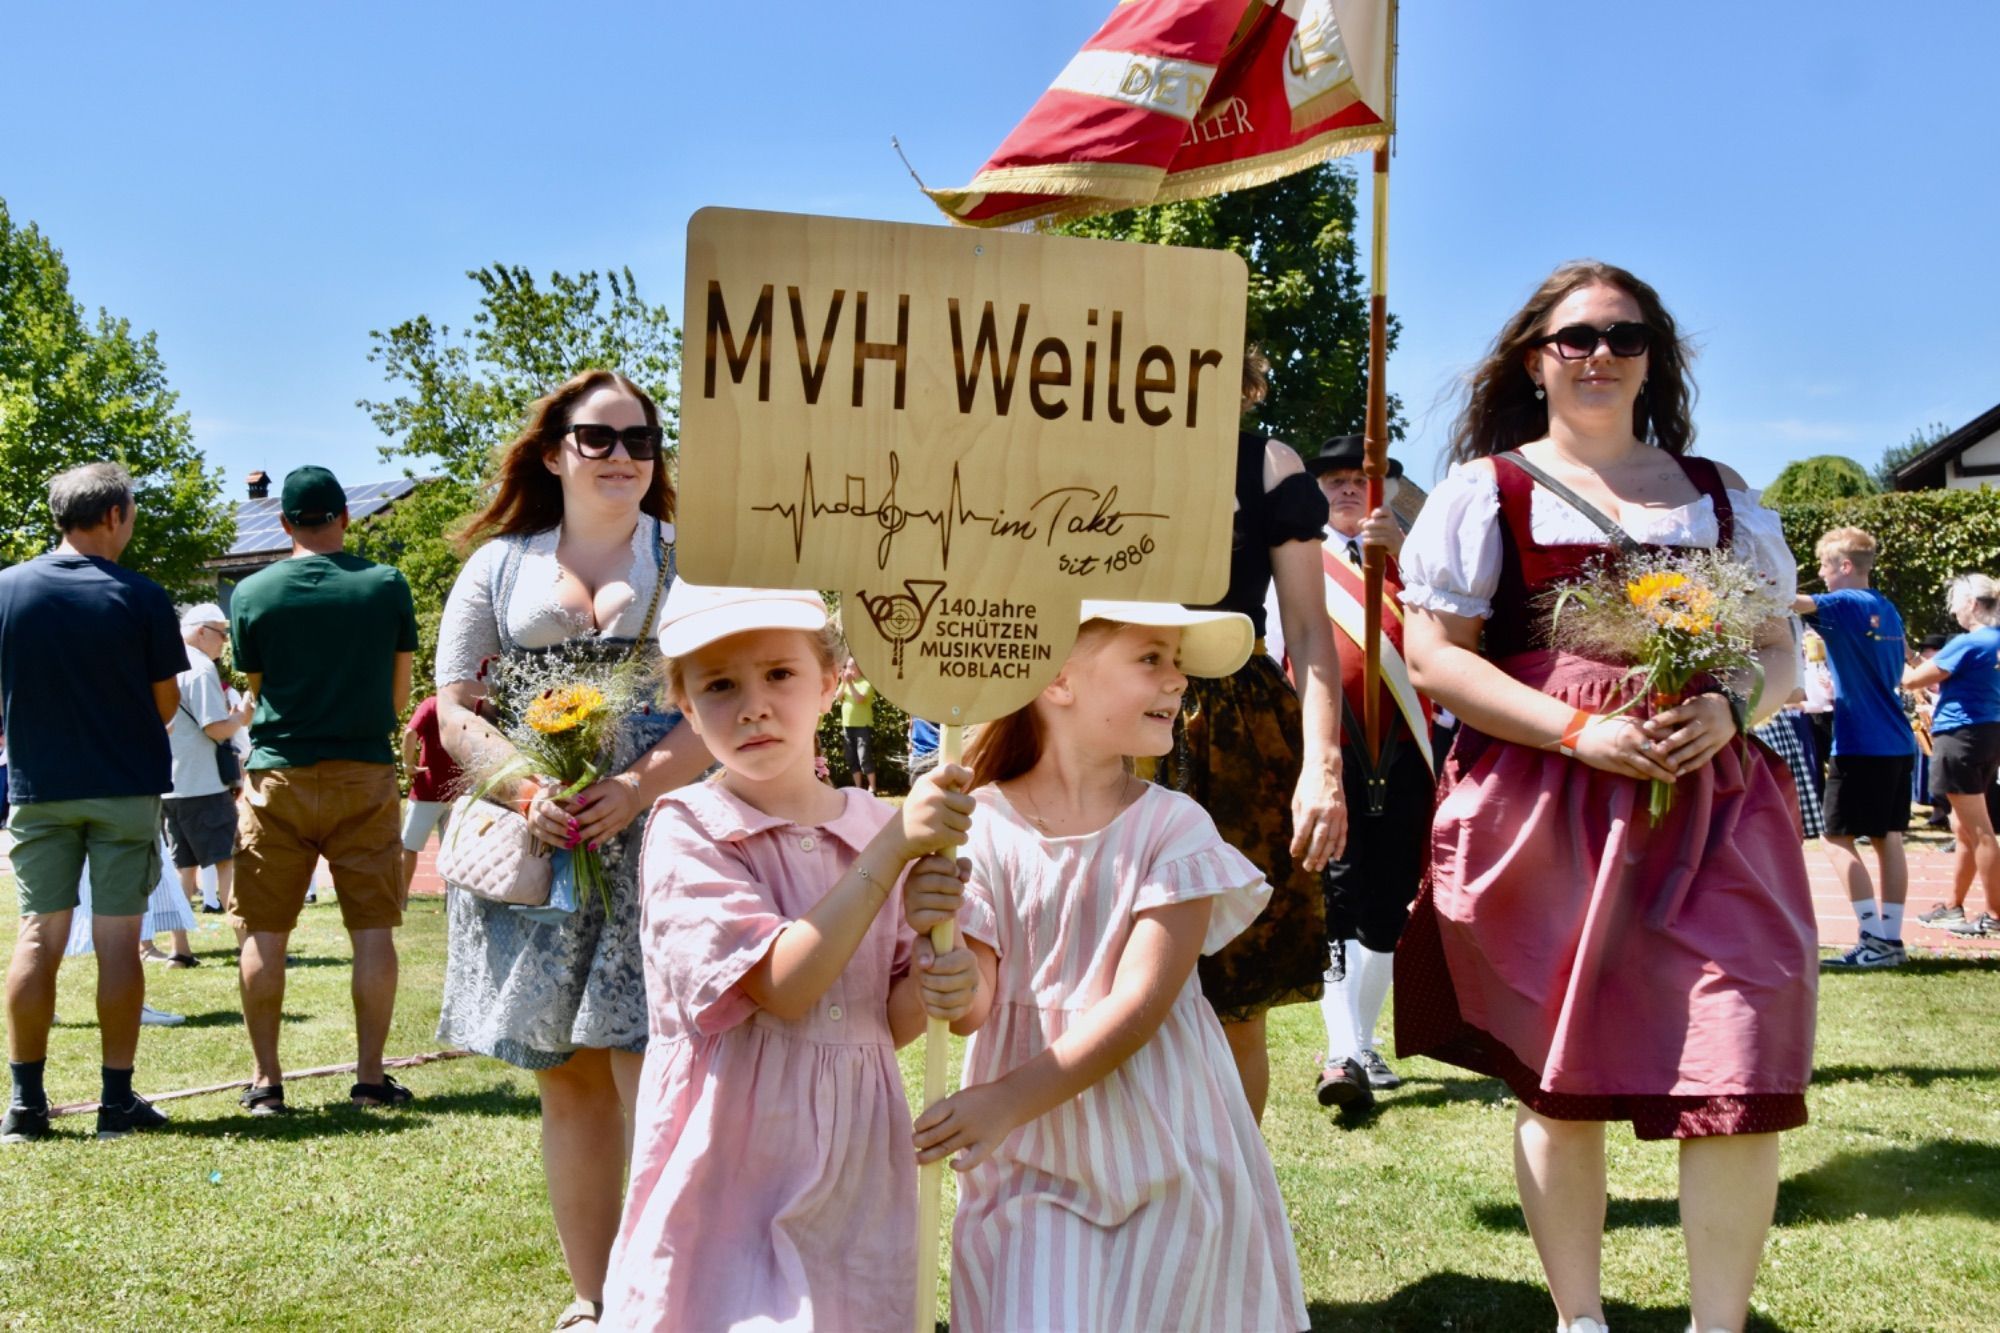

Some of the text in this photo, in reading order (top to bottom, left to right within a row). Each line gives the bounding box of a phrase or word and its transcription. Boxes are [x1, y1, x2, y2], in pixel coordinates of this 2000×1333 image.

[703, 279, 1224, 428] MVH Weiler
[990, 485, 1170, 547] im Takt
[1058, 534, 1156, 576] sit 1886
[935, 620, 1038, 640] SCHÜTZEN
[920, 641, 1052, 660] MUSIKVEREIN
[939, 661, 1031, 679] KOBLACH
